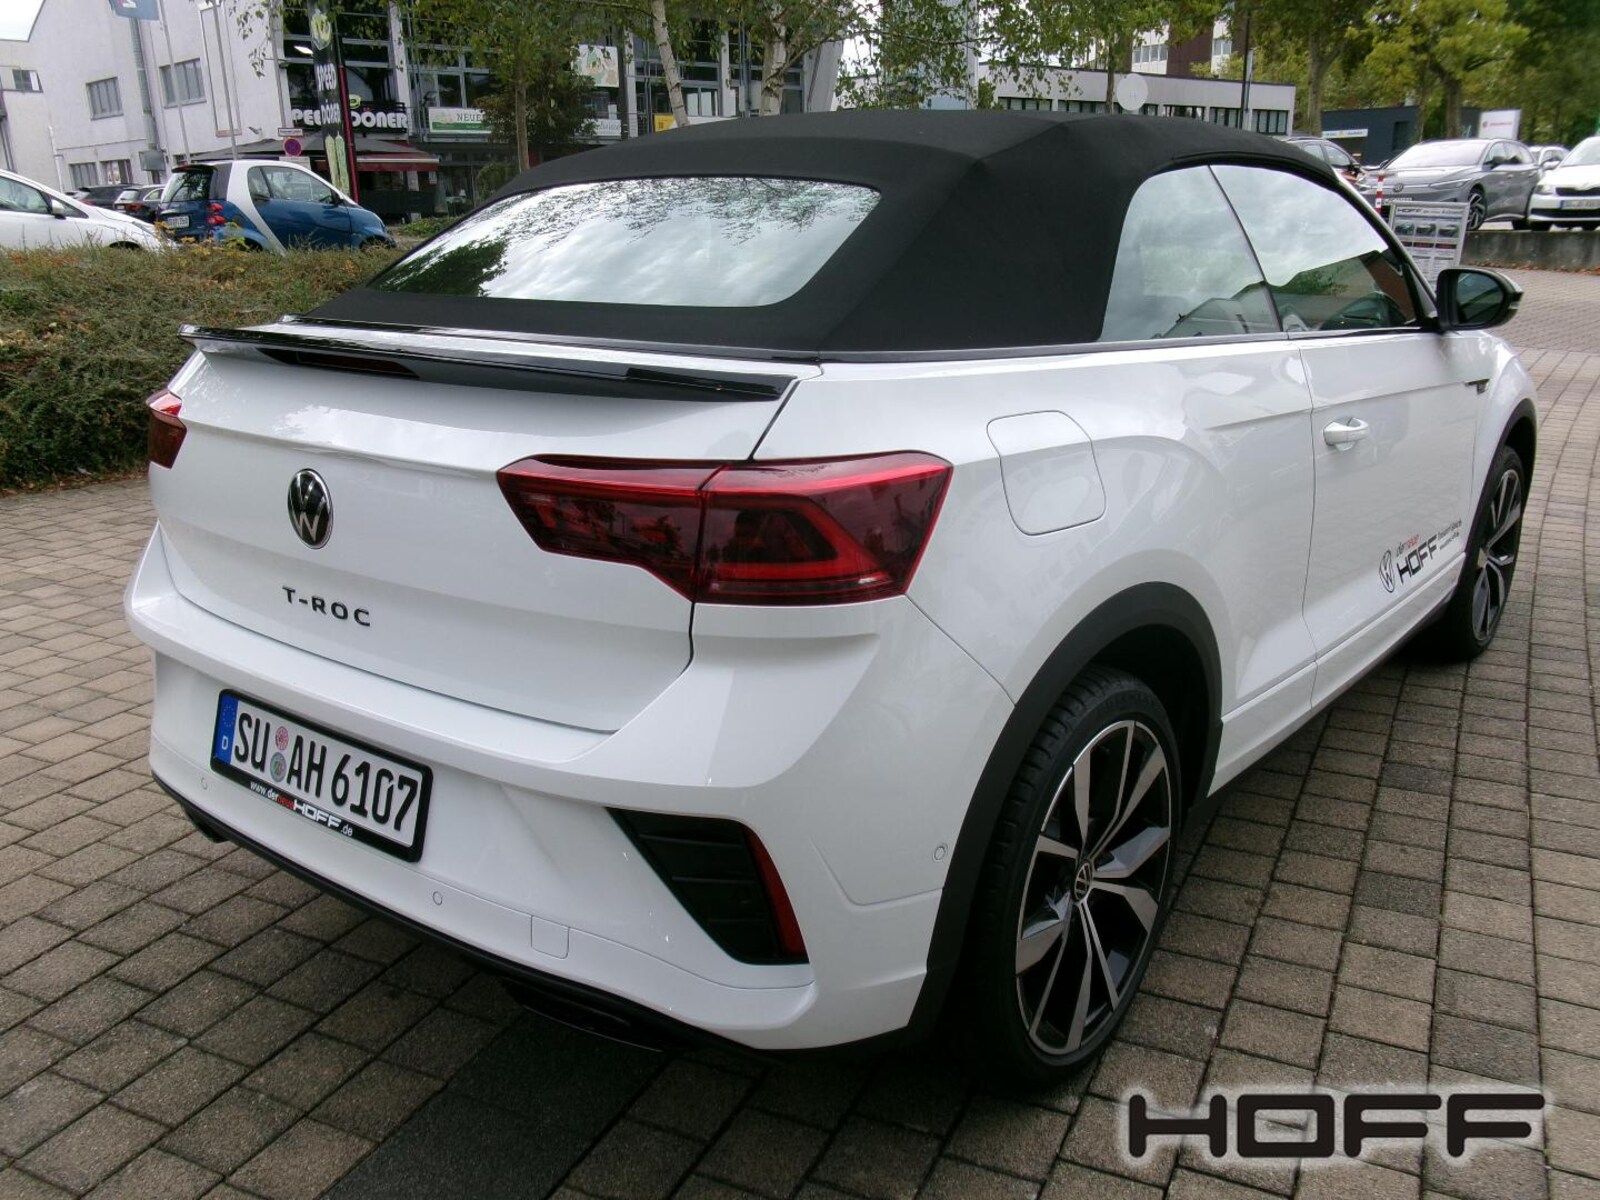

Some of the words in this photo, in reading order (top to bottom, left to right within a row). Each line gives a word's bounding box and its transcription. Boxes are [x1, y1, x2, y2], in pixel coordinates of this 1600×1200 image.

[457, 113, 486, 121] NEUE
[1396, 534, 1438, 585] HOFF
[282, 585, 371, 627] T-ROC
[234, 712, 271, 772] SU
[286, 735, 327, 798] AH
[331, 754, 419, 832] 6107
